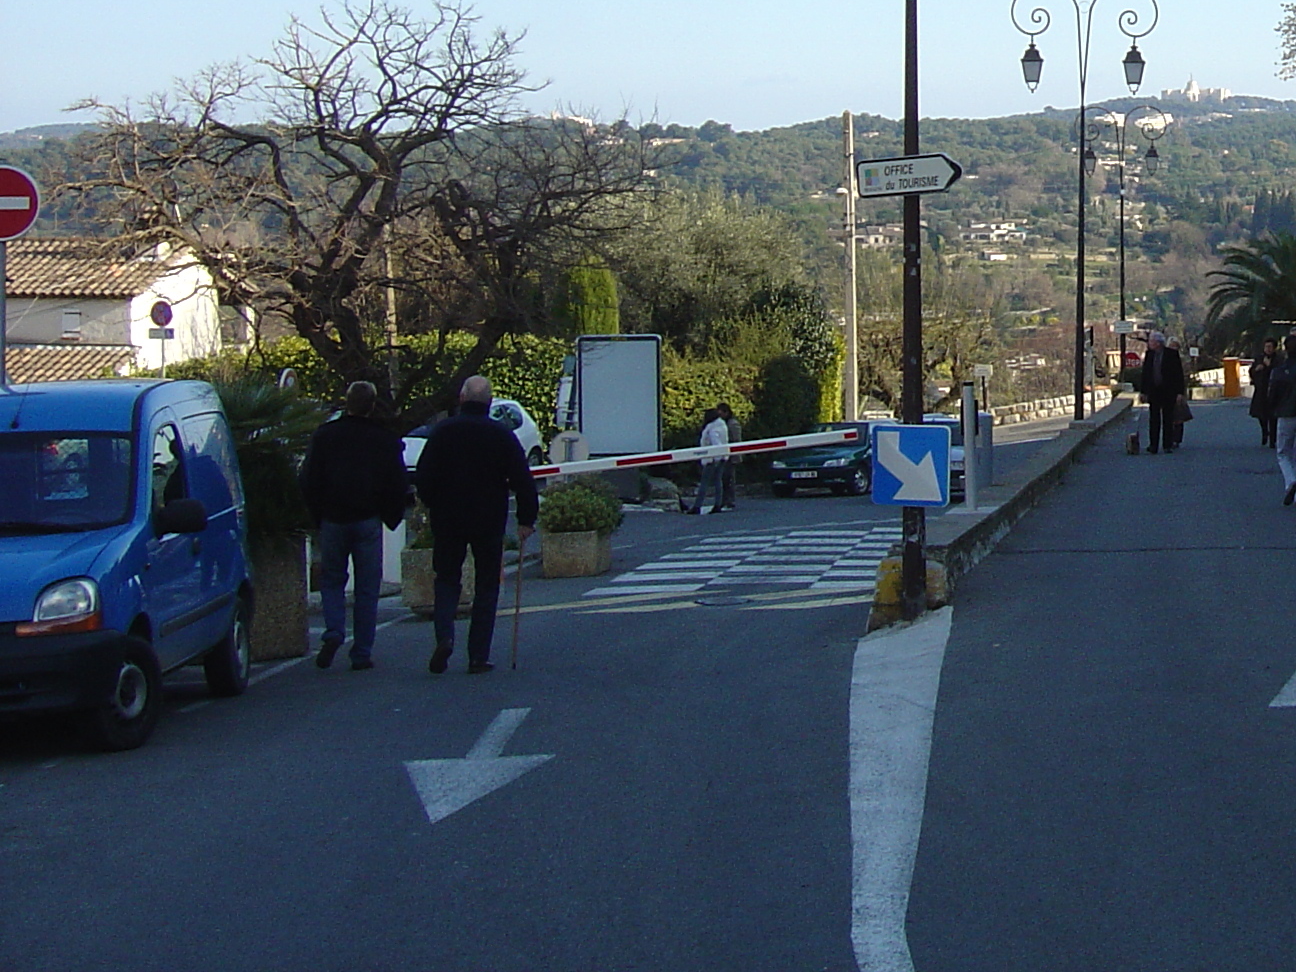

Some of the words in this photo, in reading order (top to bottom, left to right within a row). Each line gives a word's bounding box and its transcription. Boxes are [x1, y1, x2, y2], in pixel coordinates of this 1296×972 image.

[884, 163, 914, 176] OFFICE
[886, 181, 895, 190] du
[899, 175, 939, 189] TOURISME
